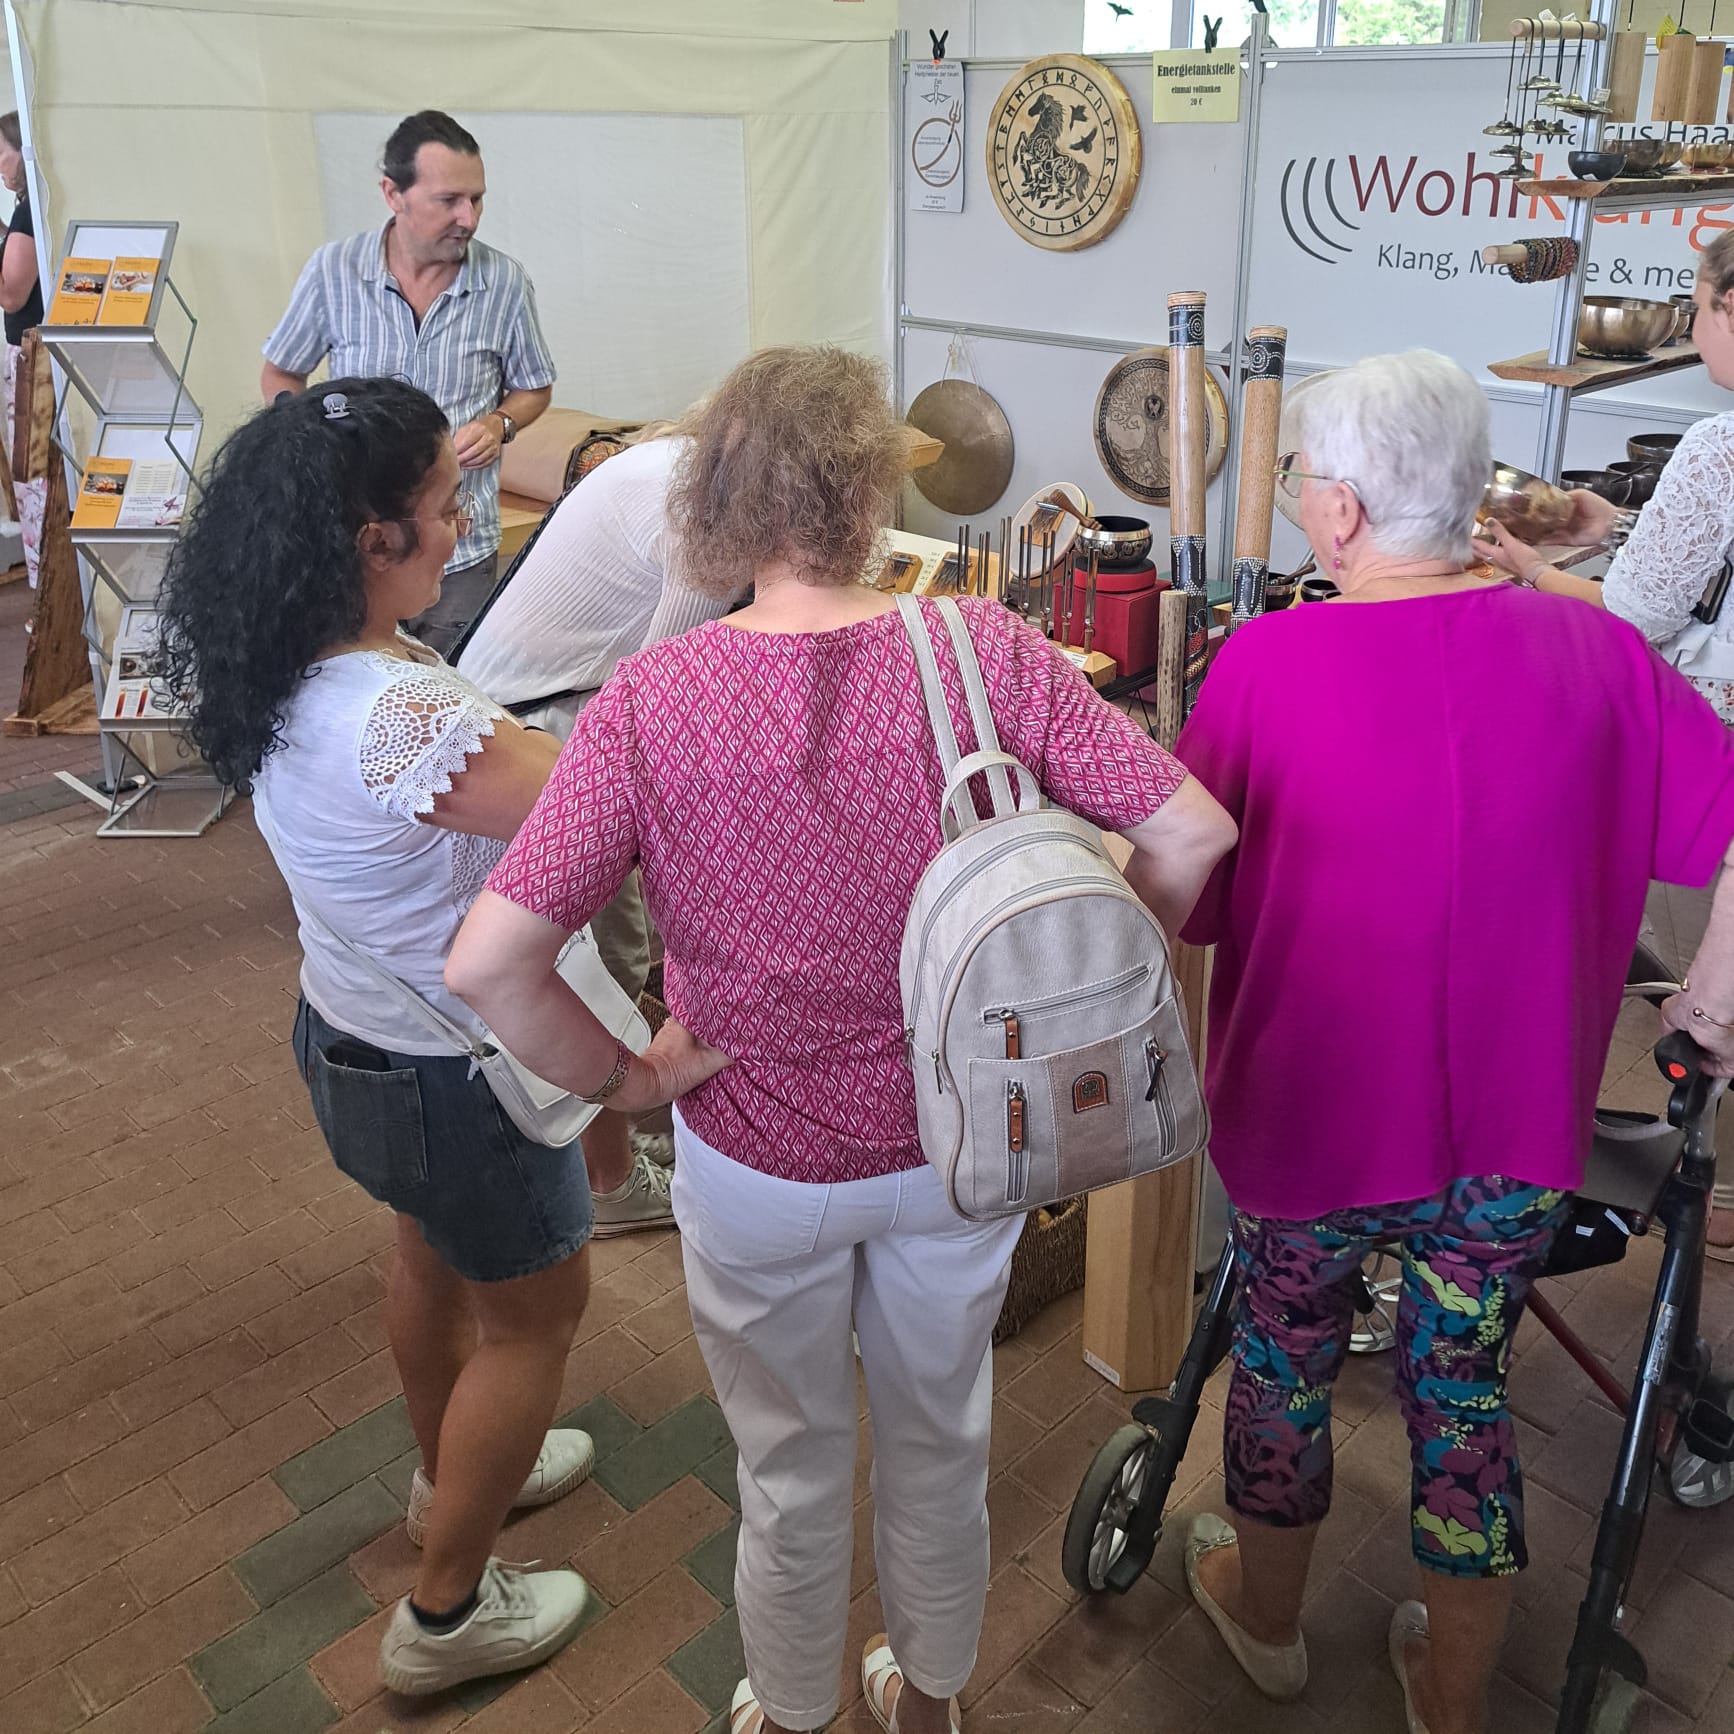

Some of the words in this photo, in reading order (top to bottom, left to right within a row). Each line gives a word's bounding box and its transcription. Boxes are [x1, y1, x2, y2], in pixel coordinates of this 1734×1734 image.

[1157, 62, 1236, 77] Energietankstelle
[1171, 85, 1192, 94] einmal
[1190, 98, 1198, 106] 20
[1198, 98, 1203, 106] €
[1666, 120, 1734, 144] Haa
[1377, 243, 1459, 280] Klang,
[1609, 258, 1633, 284] &
[1644, 266, 1695, 289] me
